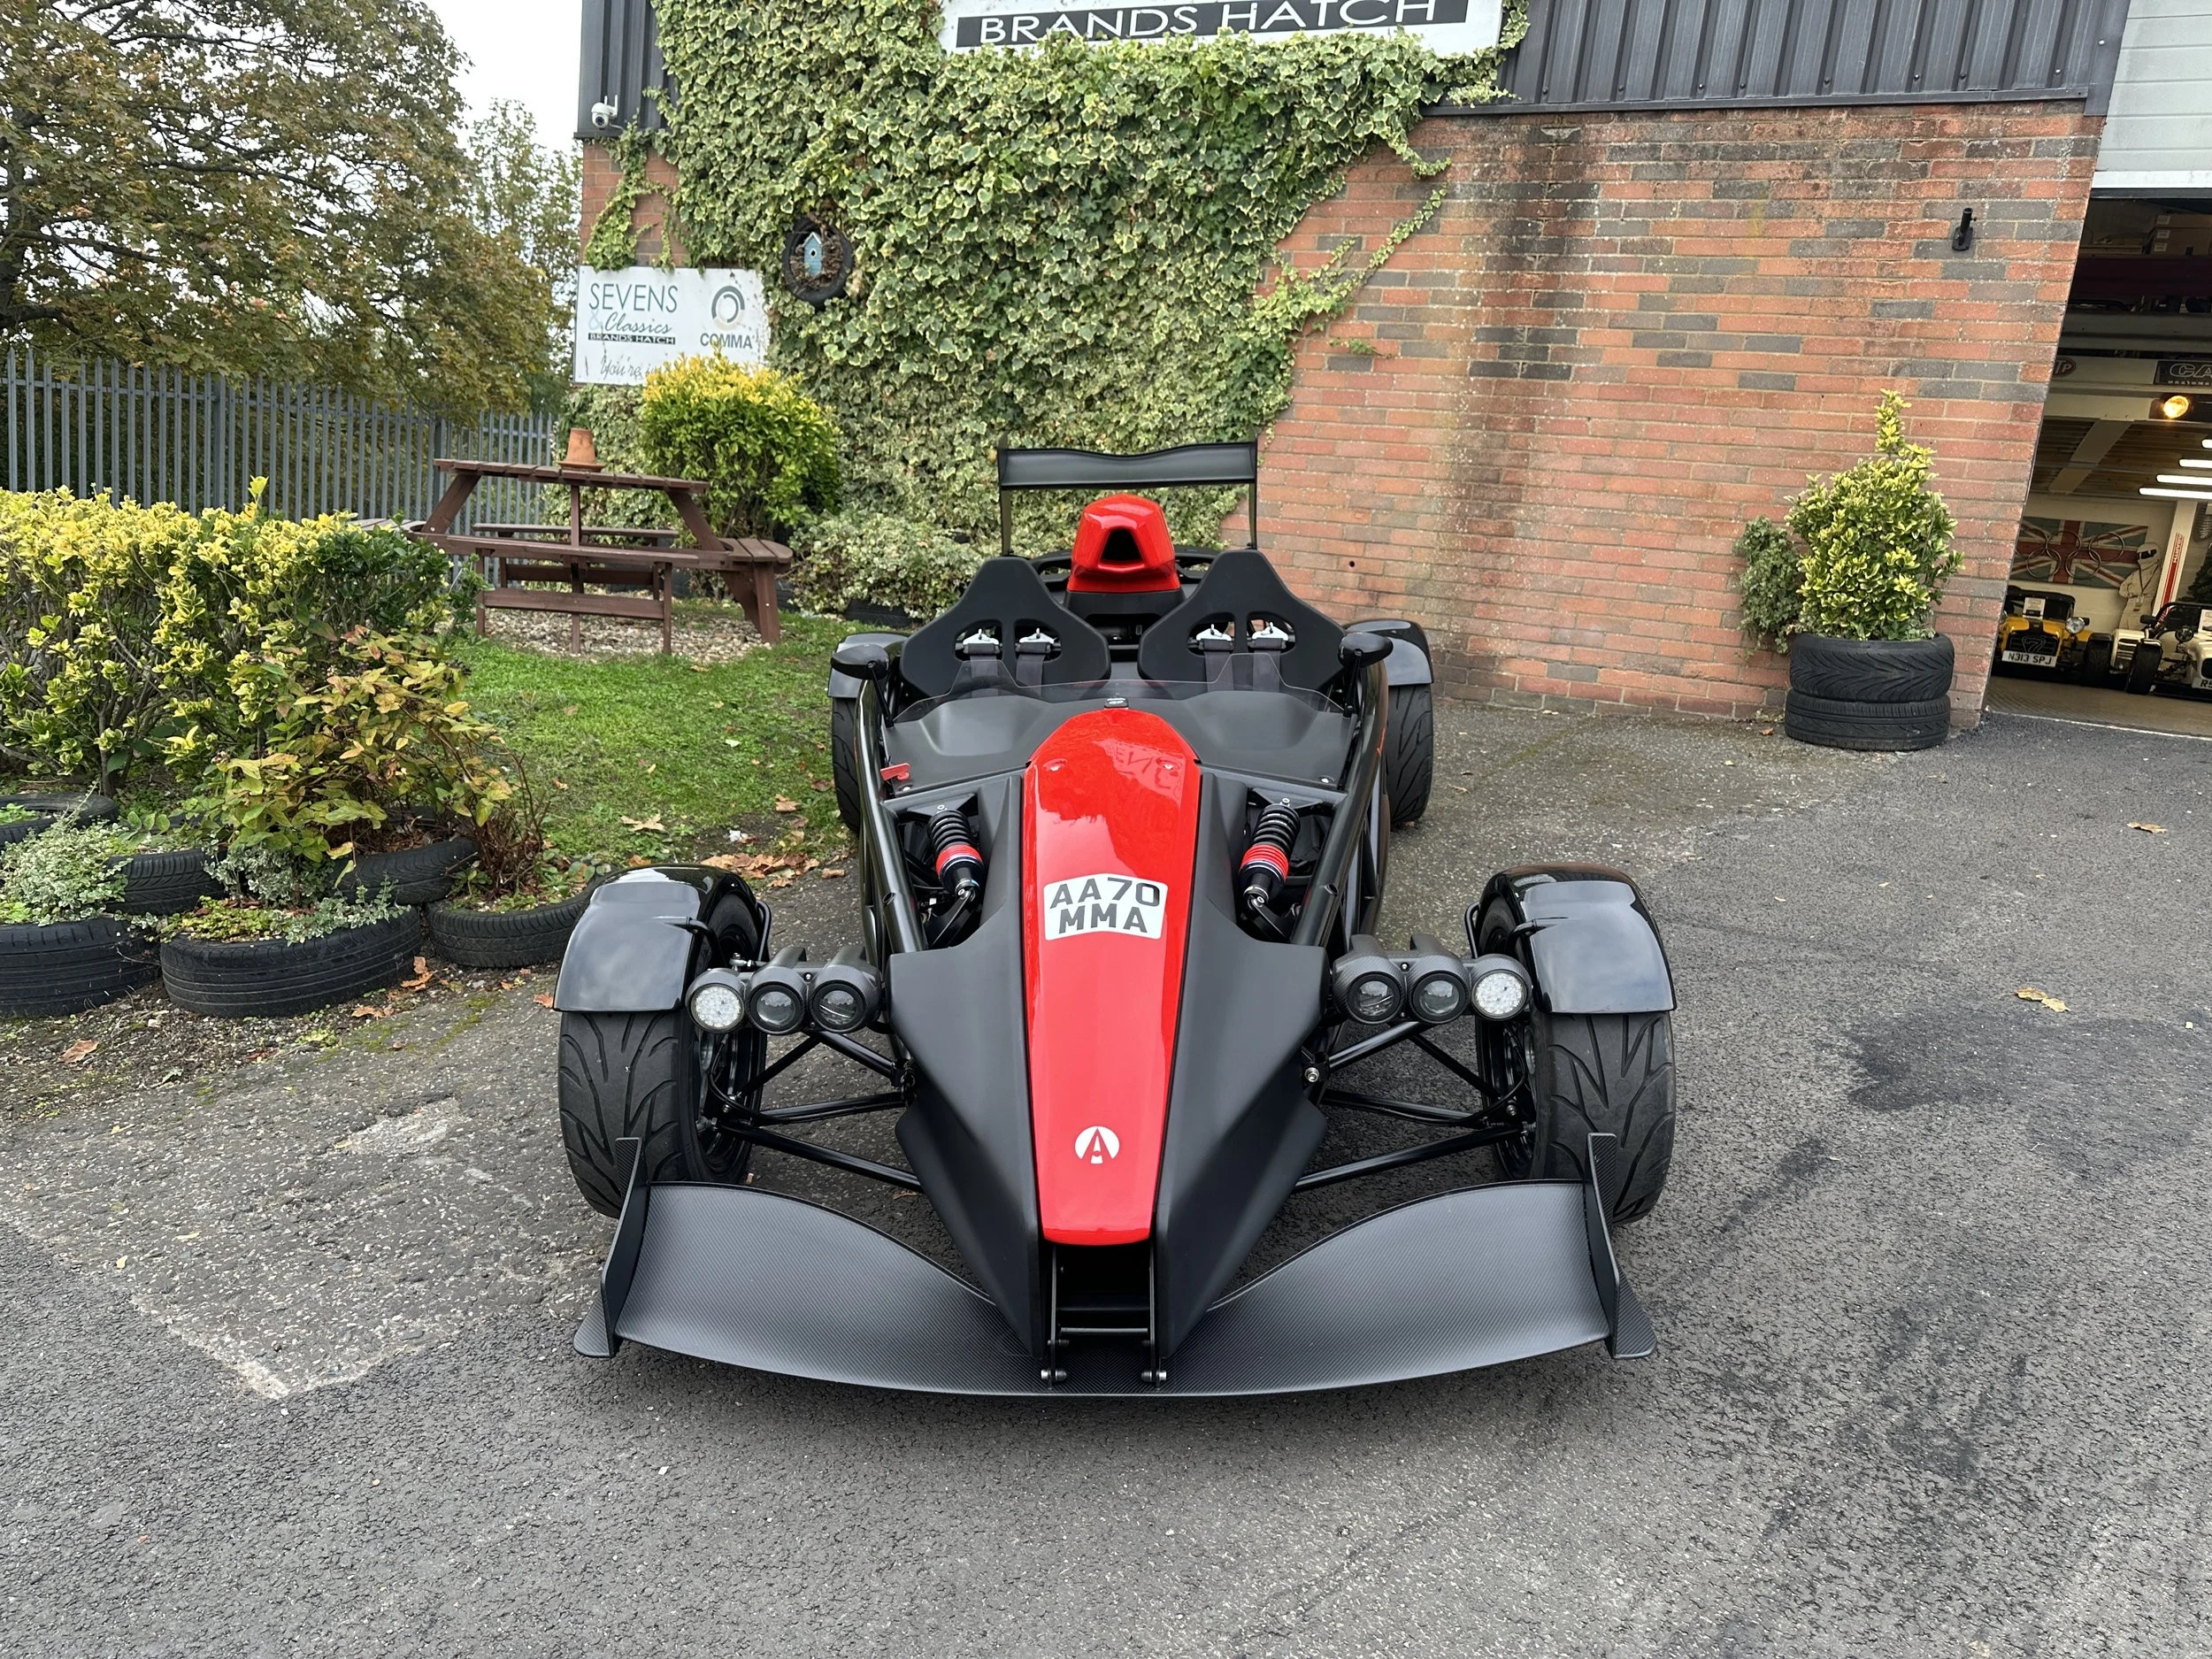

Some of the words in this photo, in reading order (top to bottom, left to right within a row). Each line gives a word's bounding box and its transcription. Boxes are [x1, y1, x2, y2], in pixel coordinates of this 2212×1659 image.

[979, 5, 1198, 43] BRANDS
[1221, 0, 1436, 30] HATCH
[588, 282, 679, 313] SEVENS
[604, 311, 672, 334] Classics
[589, 333, 634, 342] BRANDS
[635, 334, 675, 344] HATCH
[700, 333, 752, 349] COMMA
[2054, 359, 2073, 375] TP
[2008, 652, 2030, 664] N313
[2032, 656, 2052, 665] SPJ
[1050, 877, 1160, 909] AA70
[1058, 902, 1148, 934] MMA
